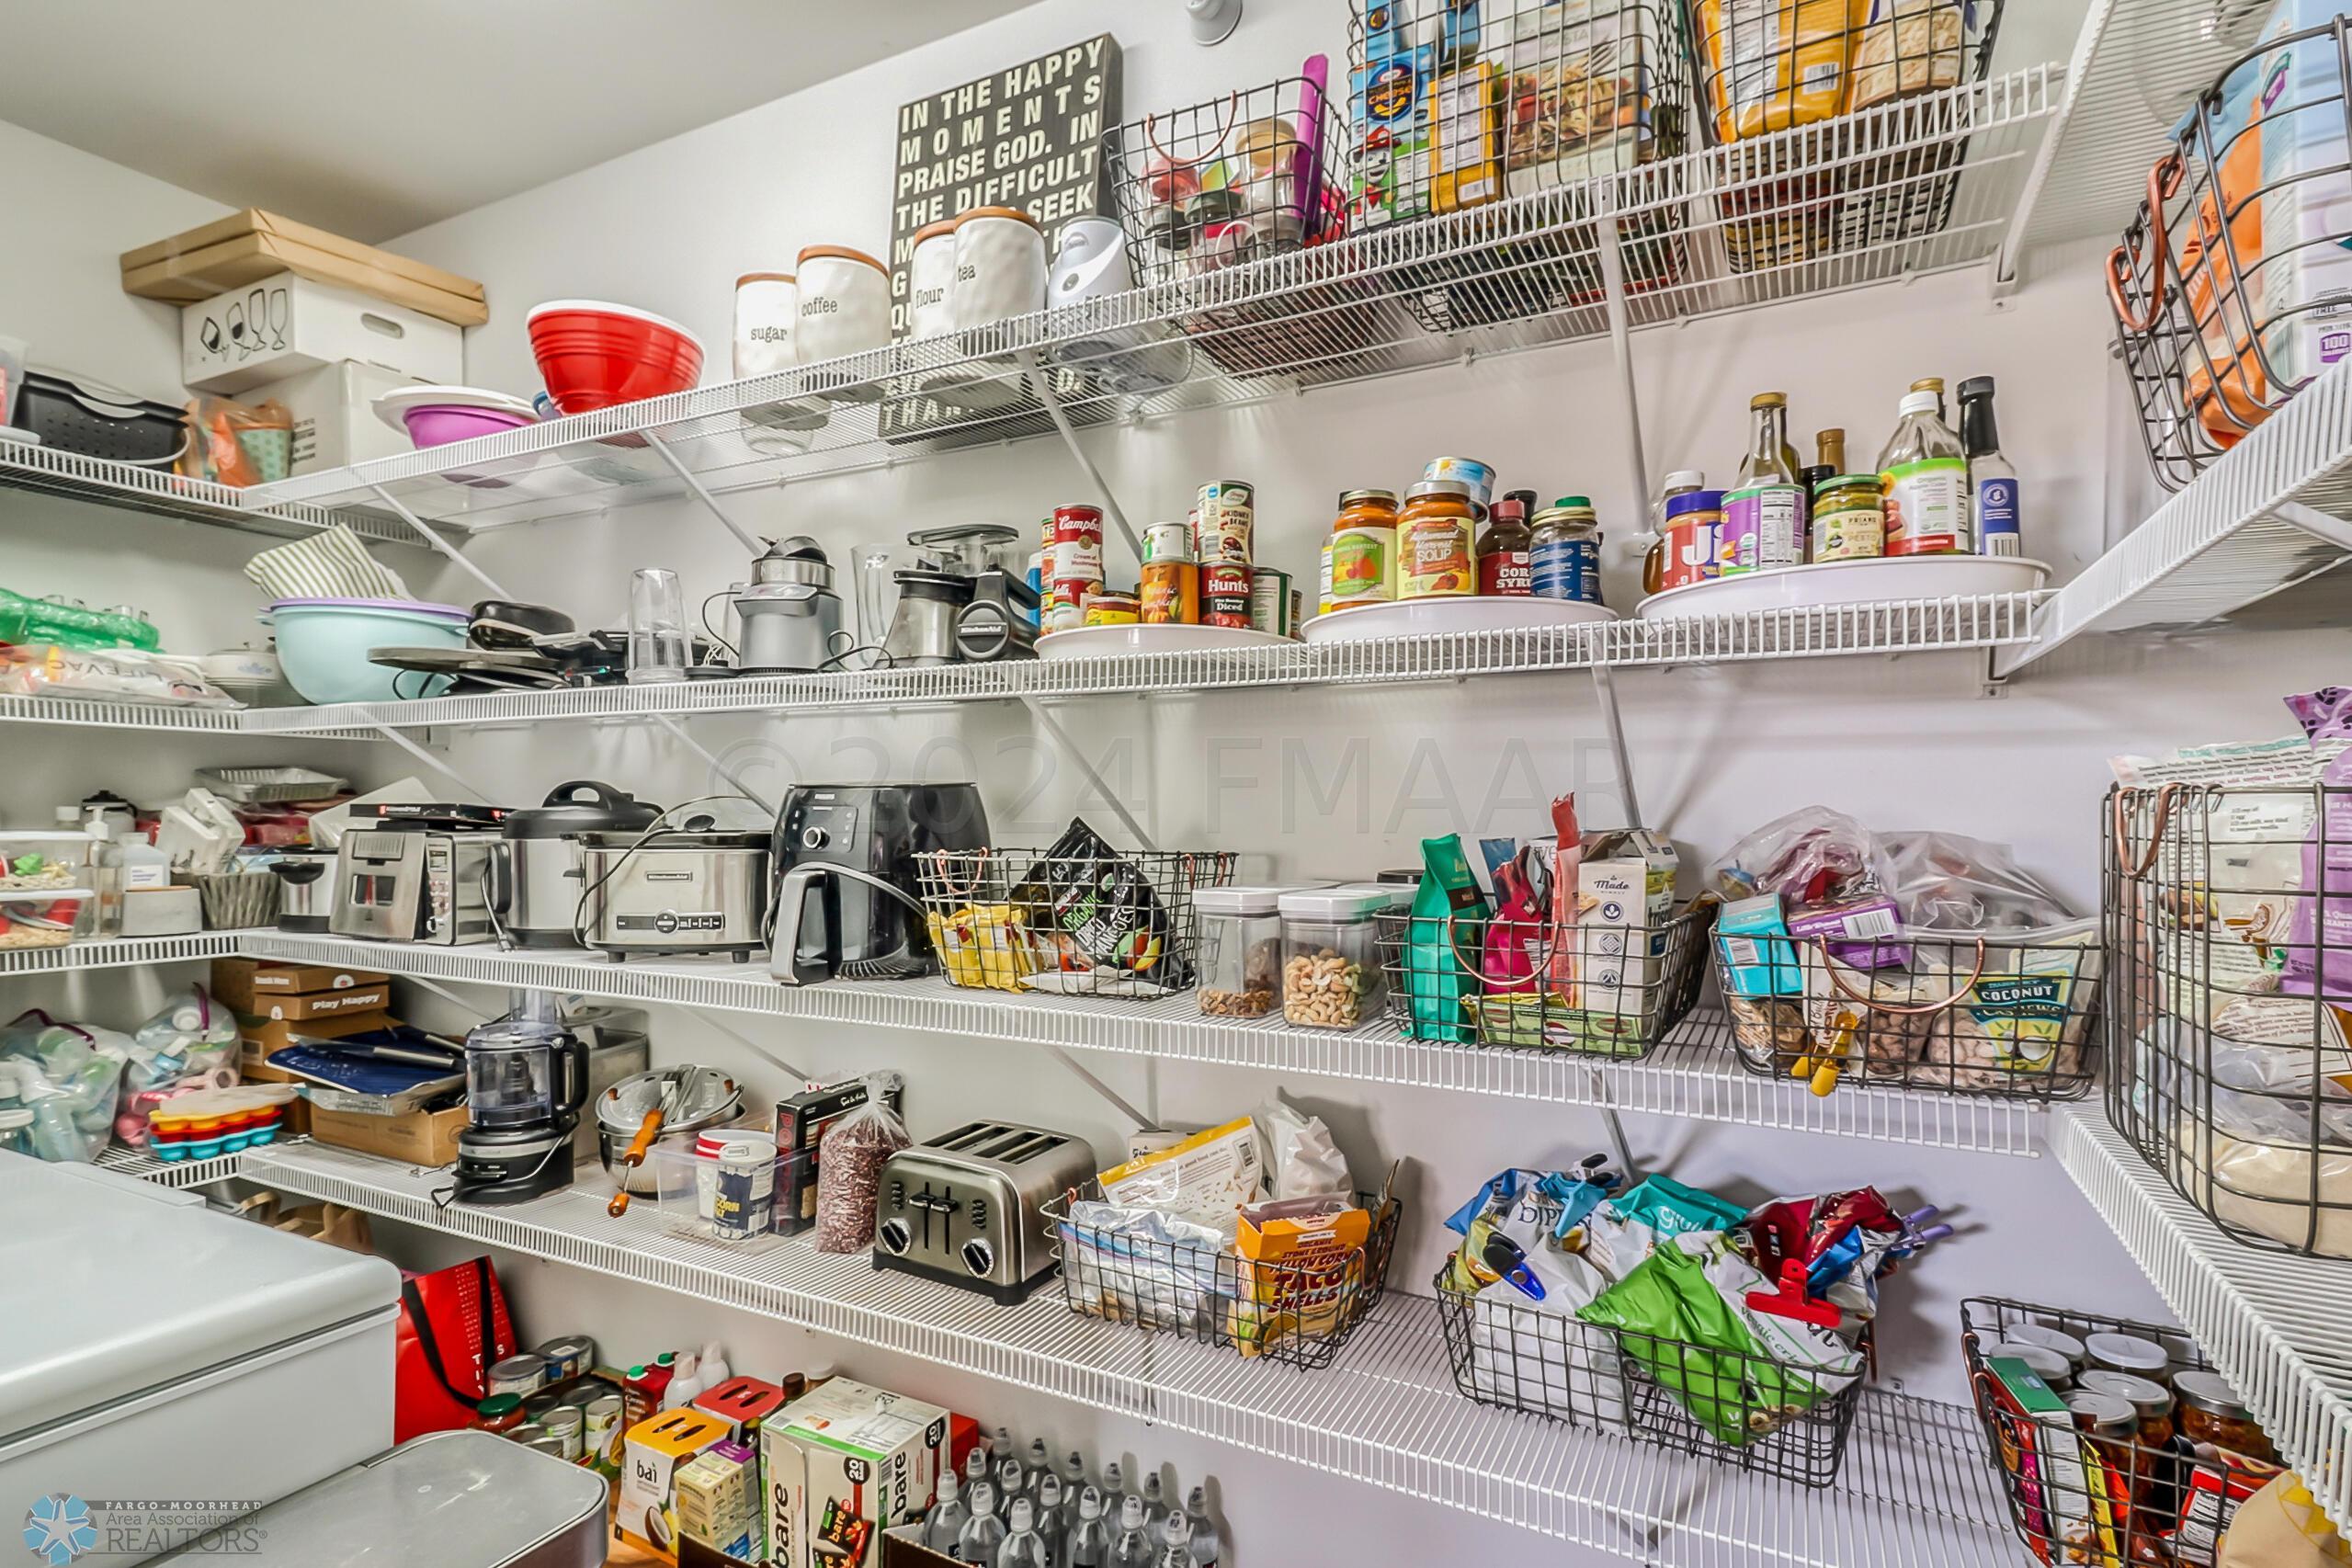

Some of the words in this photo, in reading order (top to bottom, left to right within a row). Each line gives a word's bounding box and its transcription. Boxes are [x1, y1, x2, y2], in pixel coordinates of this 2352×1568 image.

[902, 100, 929, 133] IN
[941, 79, 992, 120] THE
[1005, 38, 1104, 99] HAPPY
[900, 74, 1101, 166] MOMENTS
[898, 148, 985, 199] PRAISE
[994, 130, 1052, 170] GOD.
[1070, 109, 1098, 145] IN
[895, 194, 944, 231] THE
[955, 145, 1098, 215] DIFFICULT
[1027, 181, 1095, 223] SEEK
[958, 264, 976, 282] tea
[801, 298, 838, 317] coffee
[915, 286, 945, 309] flour
[750, 325, 788, 343] sugar
[2324, 335, 2349, 350] 100
[1417, 549, 1452, 562] SOUP
[1499, 568, 1530, 577] COR
[1208, 580, 1249, 594] Hunt's
[1217, 603, 1243, 611] Diced
[1594, 880, 1630, 890] Made
[1062, 889, 1105, 931] ORGANIC
[312, 1000, 340, 1010] Play
[342, 994, 381, 1006] Happy
[1982, 985, 2053, 1001] COCONUT
[1282, 1250, 1309, 1259] STONE
[1273, 1267, 1344, 1297] TACO
[1267, 1290, 1337, 1314] SHELLS
[929, 1426, 937, 1446] 20
[637, 1460, 657, 1483] bai
[848, 1459, 859, 1480] 20
[891, 1451, 908, 1519] bare
[771, 1483, 789, 1568] bare
[829, 1509, 846, 1543] bare
